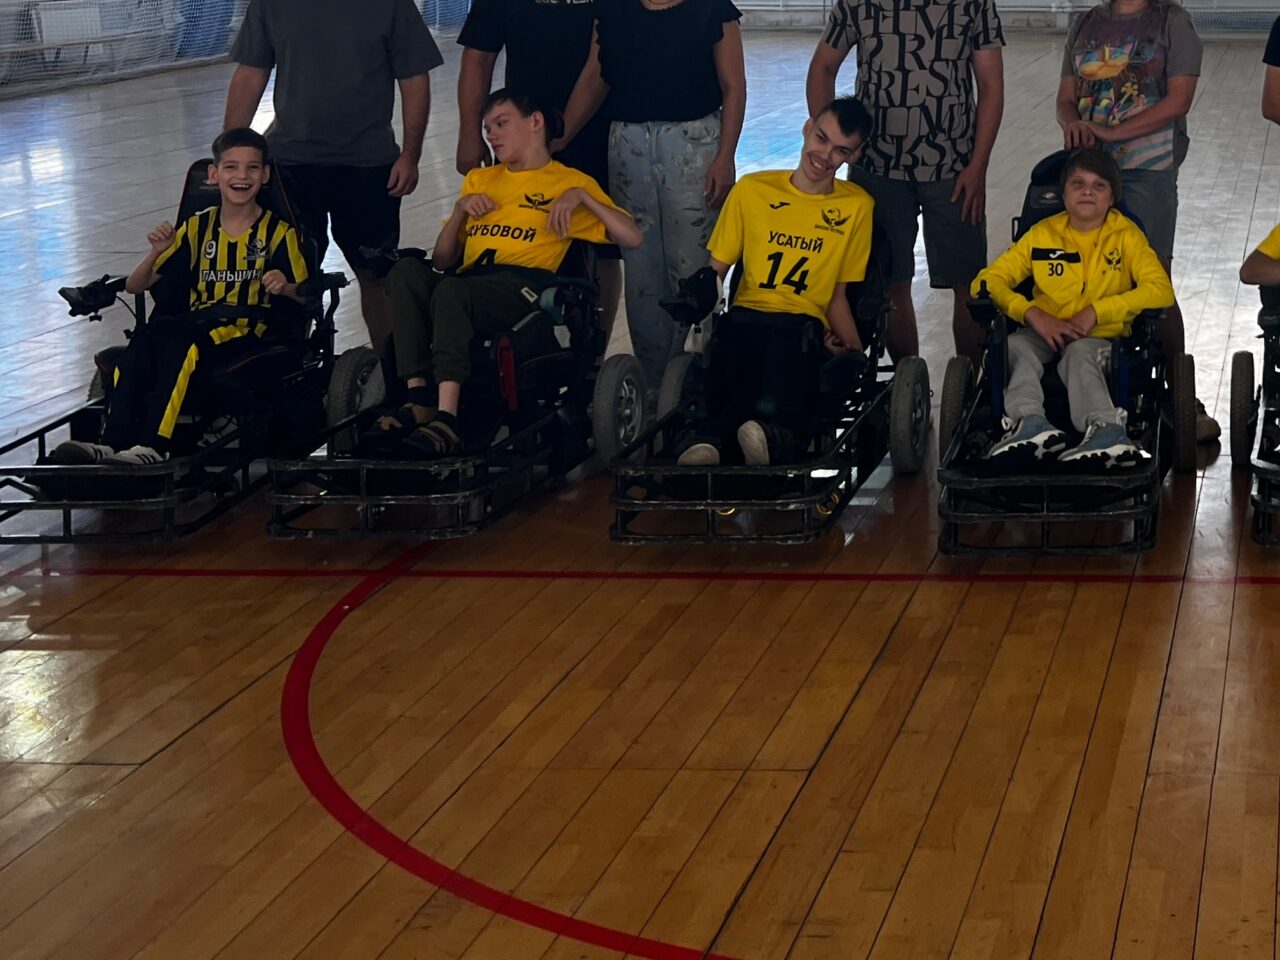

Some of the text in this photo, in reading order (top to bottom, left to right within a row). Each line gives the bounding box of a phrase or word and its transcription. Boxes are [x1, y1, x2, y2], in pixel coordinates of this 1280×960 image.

[205, 240, 216, 259] 9
[768, 230, 824, 254] УСАТЫЙ
[758, 251, 809, 295] 14
[1047, 262, 1065, 277] 30
